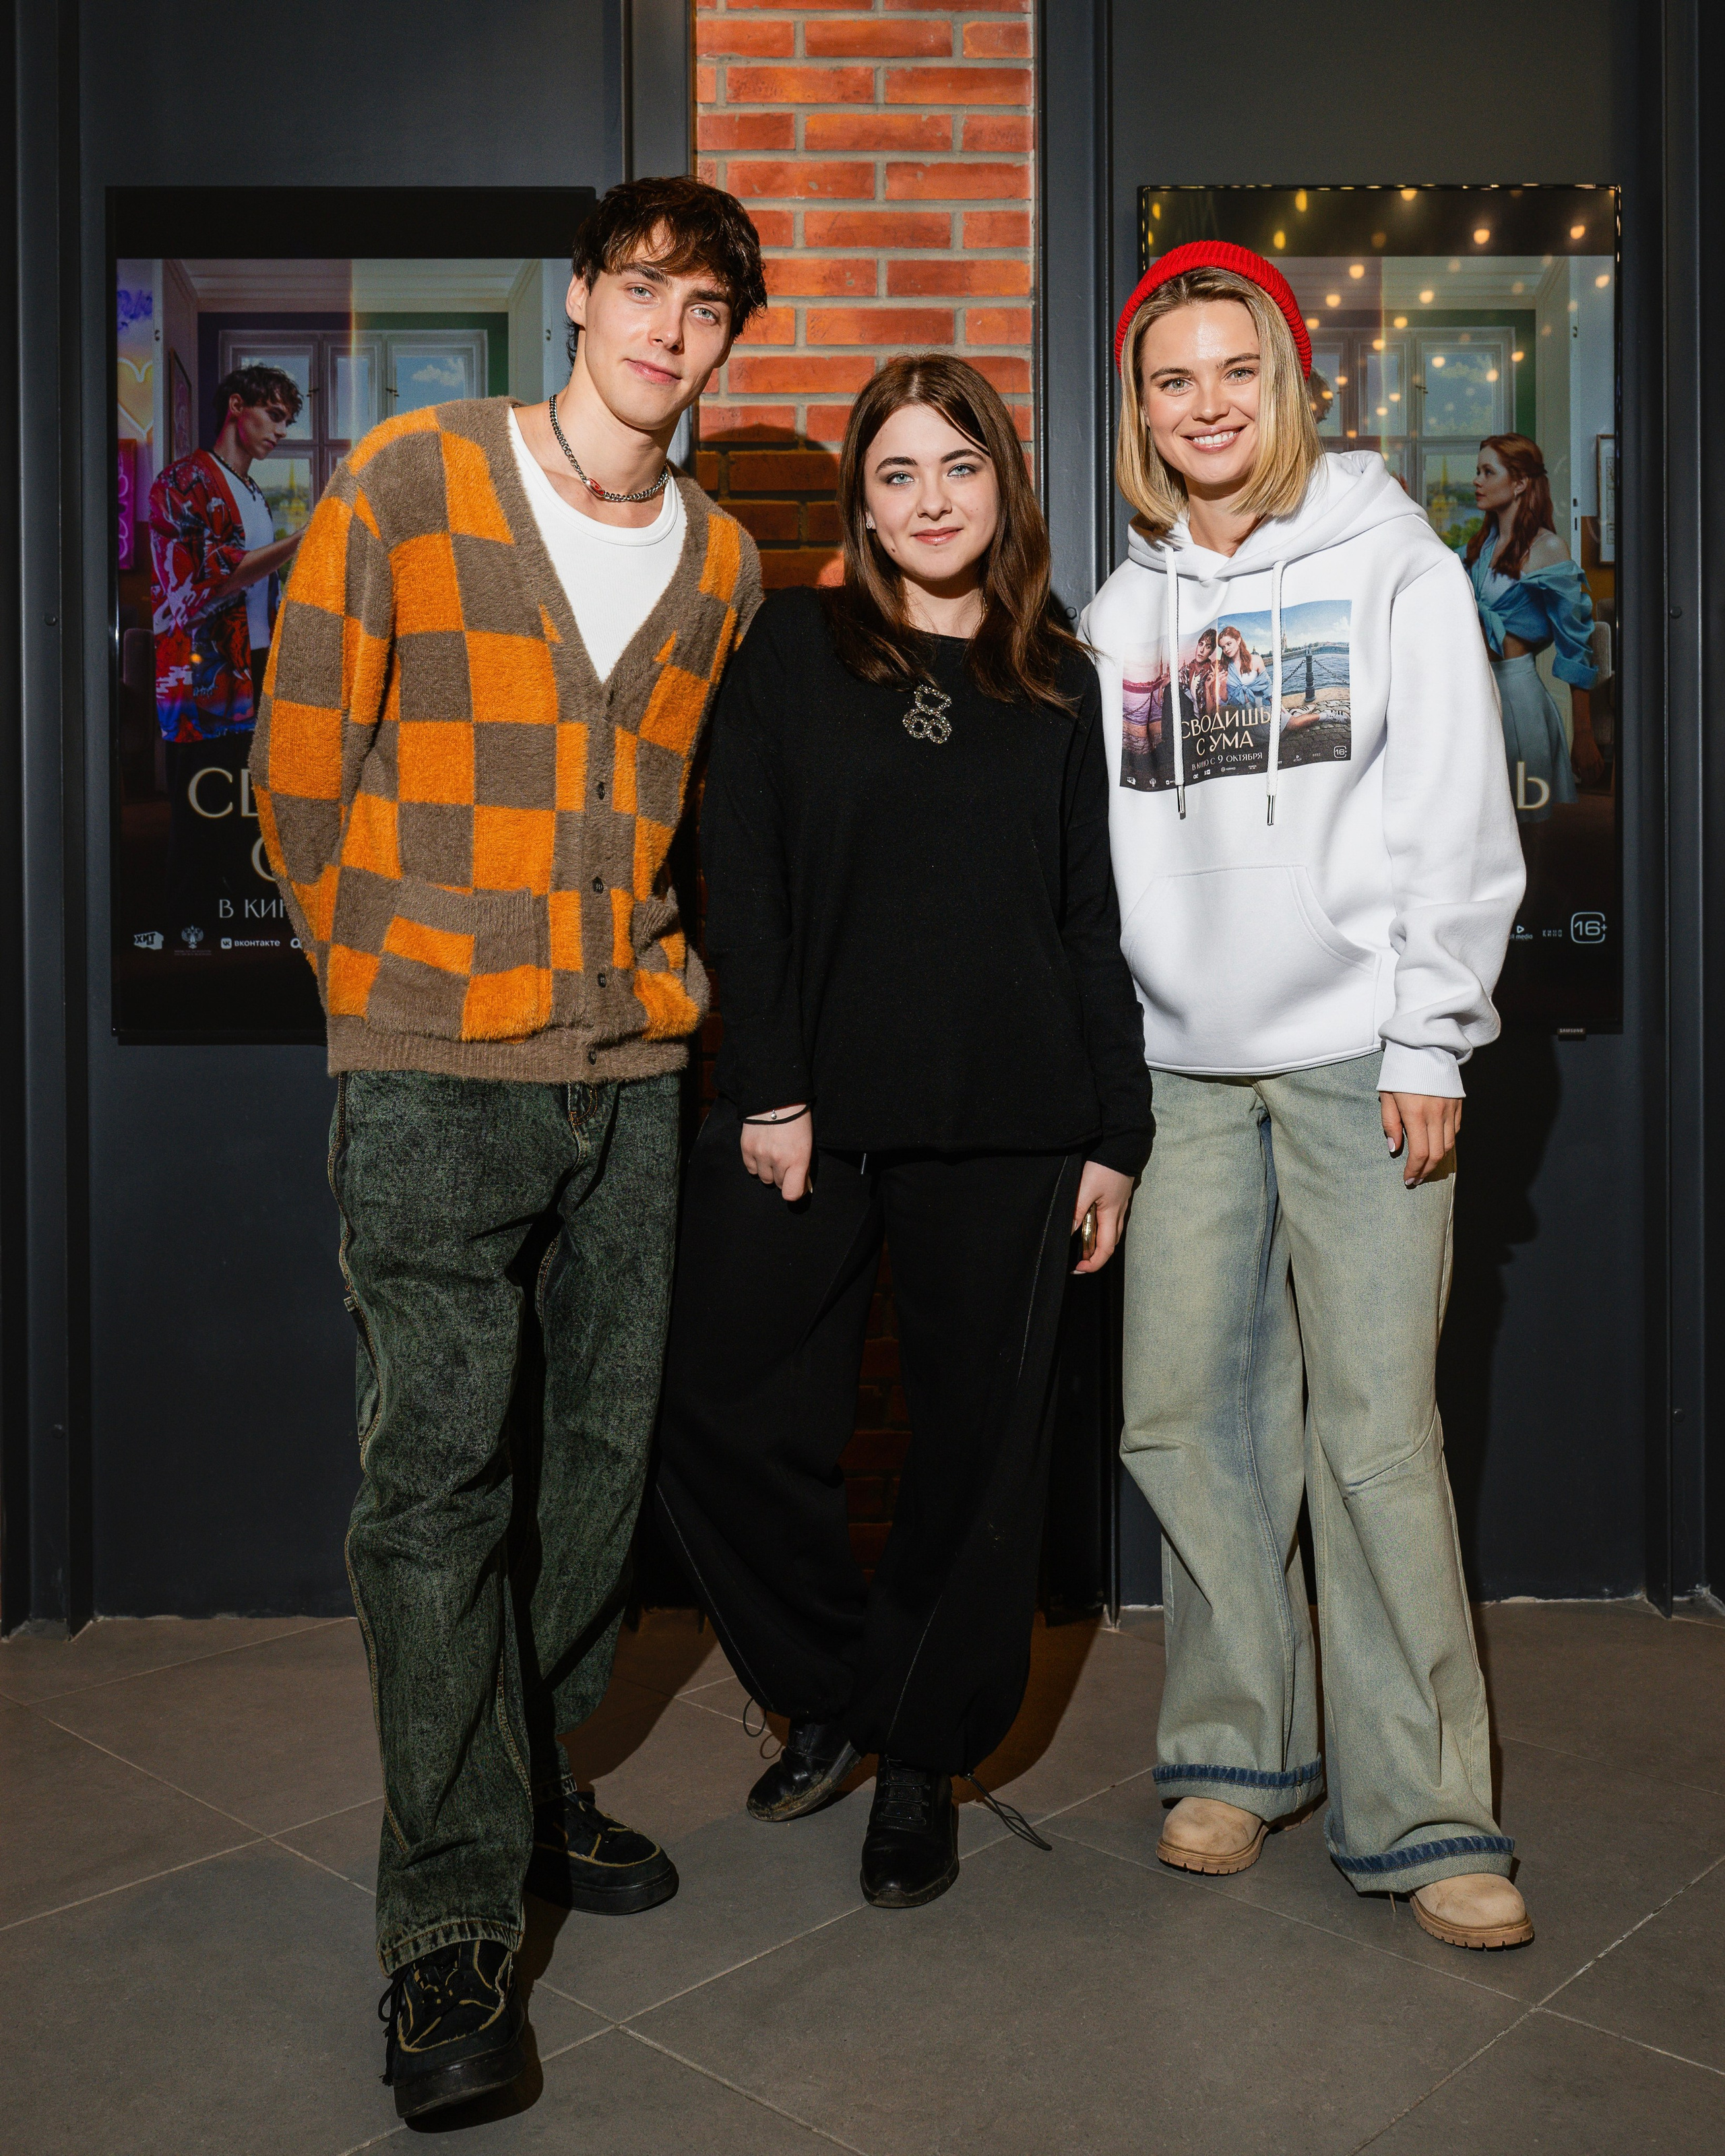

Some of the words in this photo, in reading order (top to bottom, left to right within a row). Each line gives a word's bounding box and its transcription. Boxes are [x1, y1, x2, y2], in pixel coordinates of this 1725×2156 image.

[1181, 706, 1272, 739] СВОДИШЬ
[1196, 738, 1205, 755] С
[1209, 730, 1254, 753] УМА
[1218, 755, 1224, 763] 9
[1226, 752, 1263, 763] ОКТЯБРЯ
[219, 899, 234, 918] В
[1574, 920, 1607, 936] 16+
